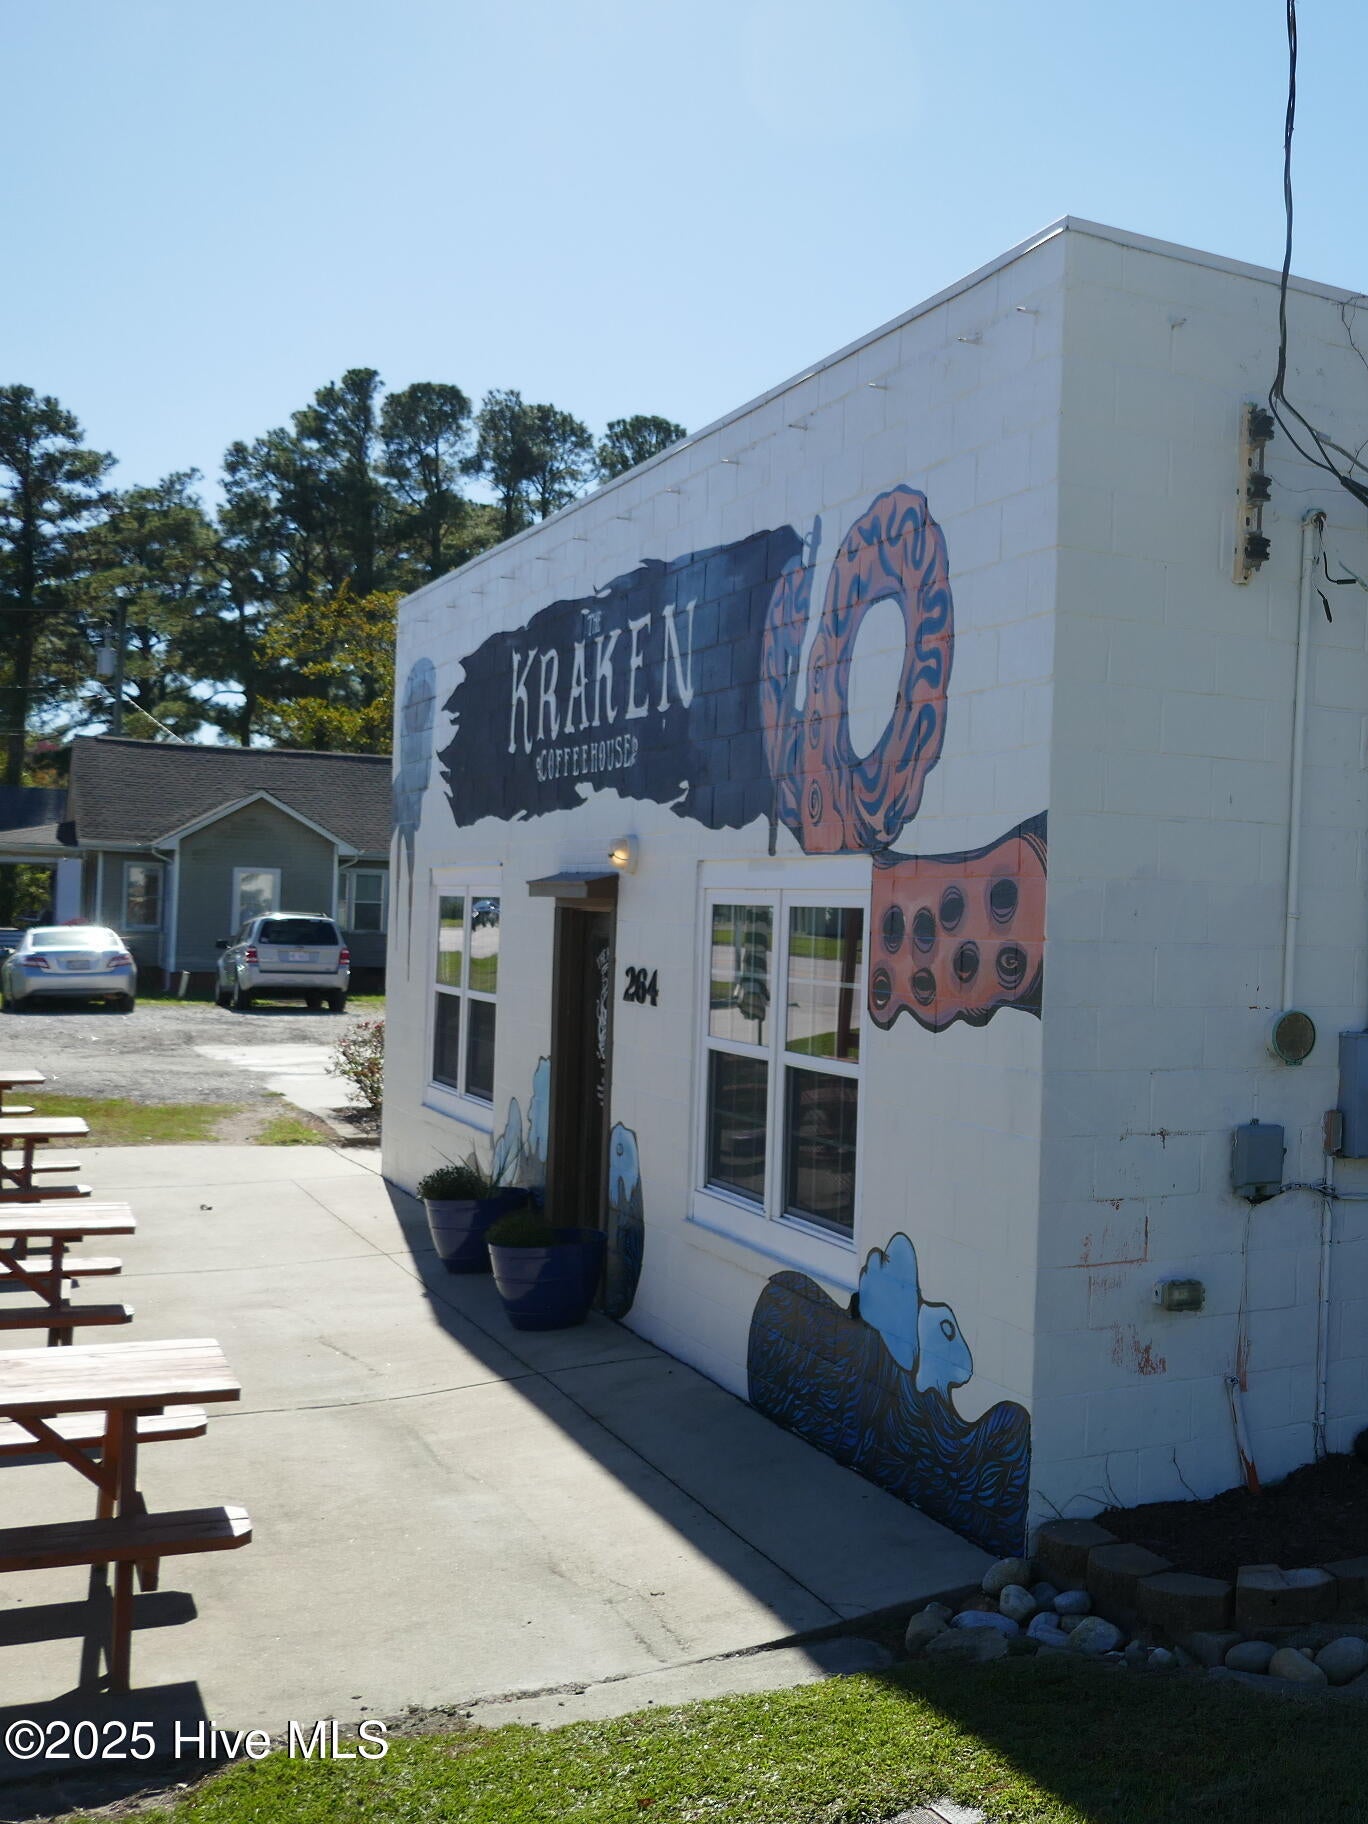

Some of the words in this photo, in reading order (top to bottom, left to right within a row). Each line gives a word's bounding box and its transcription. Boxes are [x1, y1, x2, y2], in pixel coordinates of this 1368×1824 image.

[508, 598, 697, 754] KRAKEN
[539, 733, 632, 782] COFFEEHOUSE
[623, 966, 659, 1007] 264
